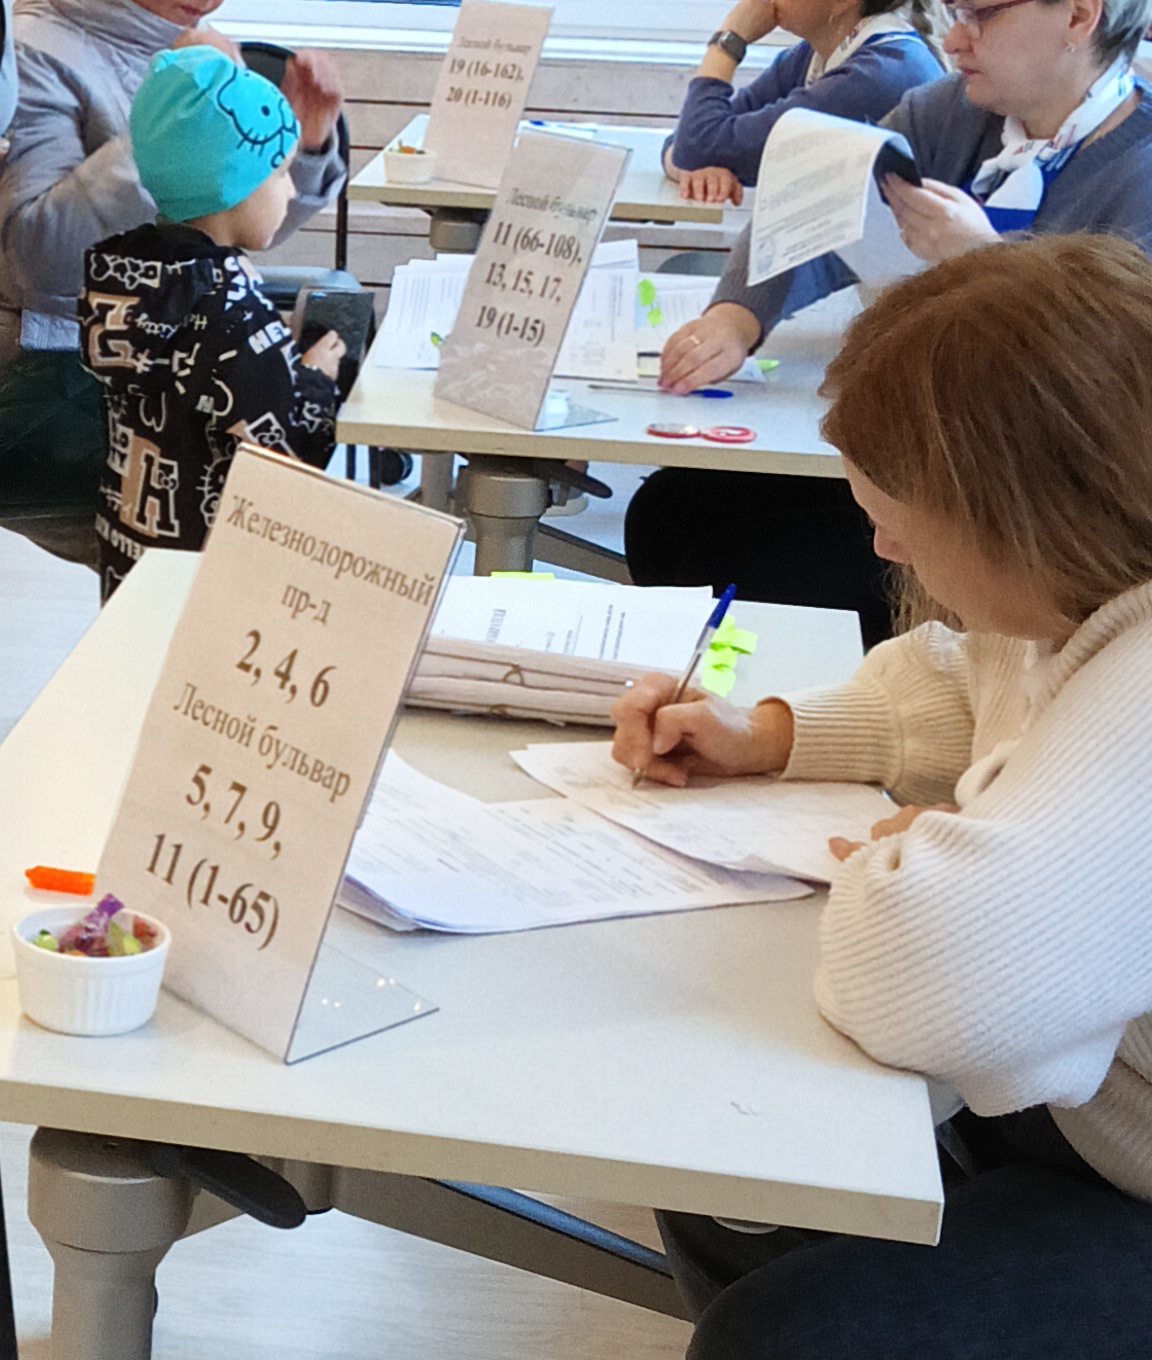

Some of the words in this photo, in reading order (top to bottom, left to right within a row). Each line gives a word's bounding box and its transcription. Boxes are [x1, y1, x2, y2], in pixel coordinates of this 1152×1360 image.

[449, 58, 466, 74] 19
[446, 86, 464, 102] 20
[464, 88, 512, 110] (1-116)
[492, 220, 512, 246] 11
[485, 262, 507, 293] 13,
[511, 268, 534, 299] 15,
[539, 275, 562, 306] 17,
[476, 305, 497, 329] 19
[497, 310, 546, 348] (1-15)
[226, 494, 437, 607] Железнодорожный
[281, 584, 332, 625] пр-д
[235, 629, 262, 686] 2,
[273, 648, 298, 704] 4,
[310, 665, 337, 707] 6
[173, 682, 257, 748] Лесной
[258, 724, 352, 803] бульвар
[186, 763, 212, 820] 5,
[224, 781, 248, 840] 7,
[256, 800, 282, 860] 9,
[146, 833, 183, 886] 11
[186, 858, 280, 951] (1-65)
